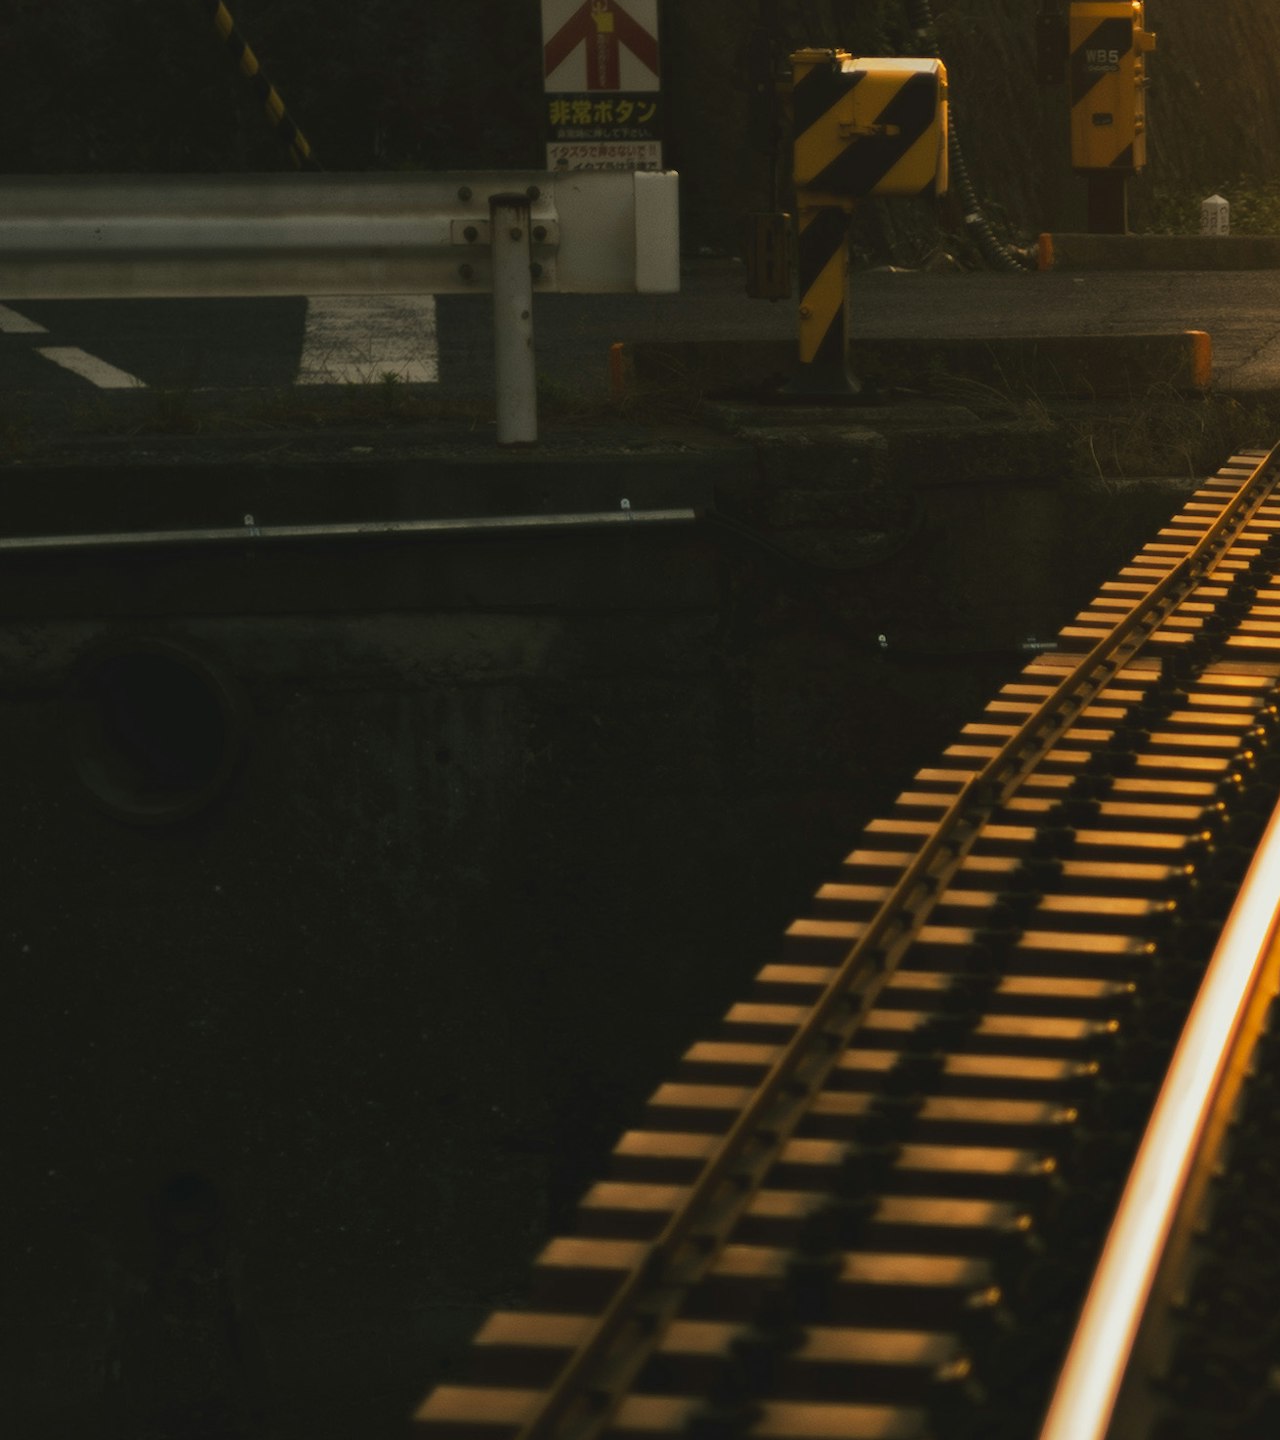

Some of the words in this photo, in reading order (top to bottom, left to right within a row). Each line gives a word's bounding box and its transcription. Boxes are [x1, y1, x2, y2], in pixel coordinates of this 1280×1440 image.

[548, 99, 657, 125] 非常ボタン
